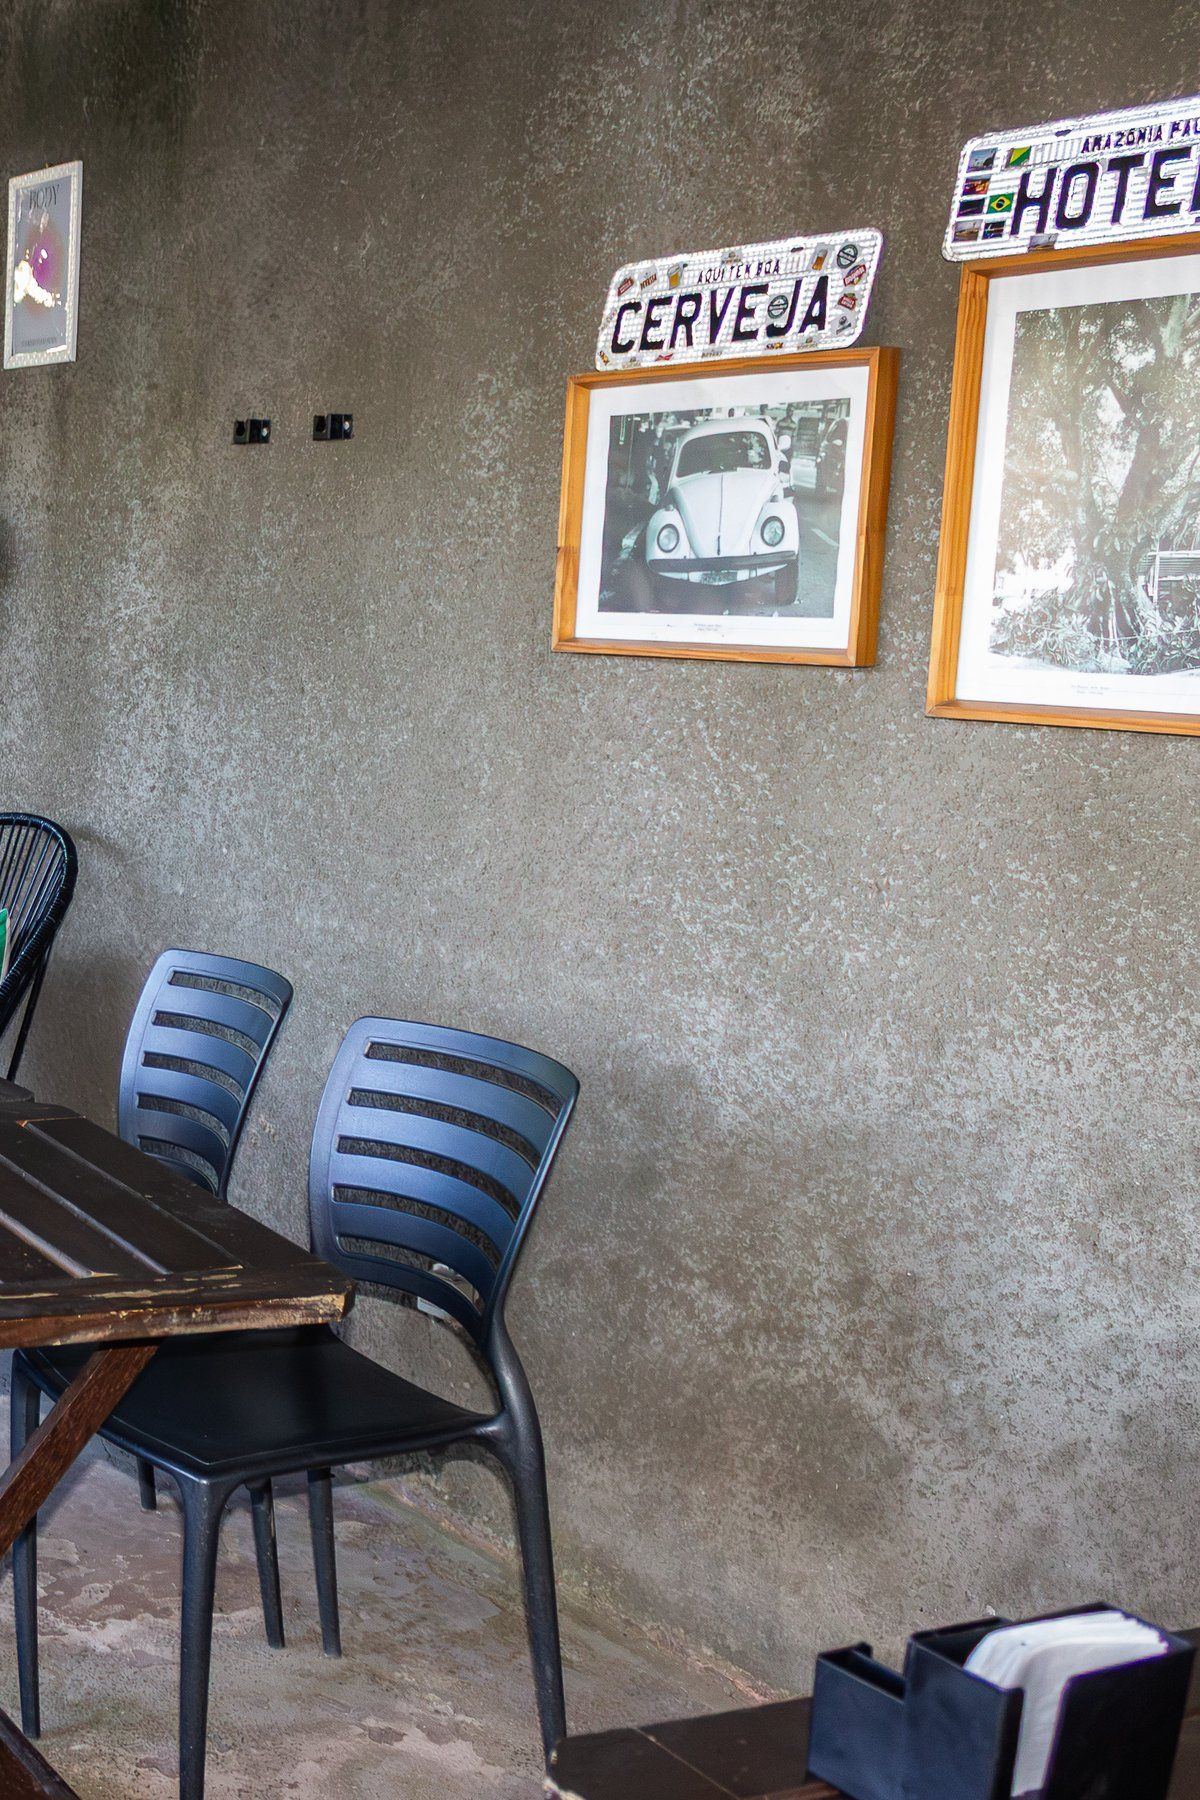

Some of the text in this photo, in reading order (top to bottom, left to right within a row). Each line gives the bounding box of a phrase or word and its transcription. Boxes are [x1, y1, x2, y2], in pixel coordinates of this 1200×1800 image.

[28, 183, 60, 210] BODY
[1010, 147, 1200, 236] HOTE
[611, 275, 829, 354] CERVEJA
